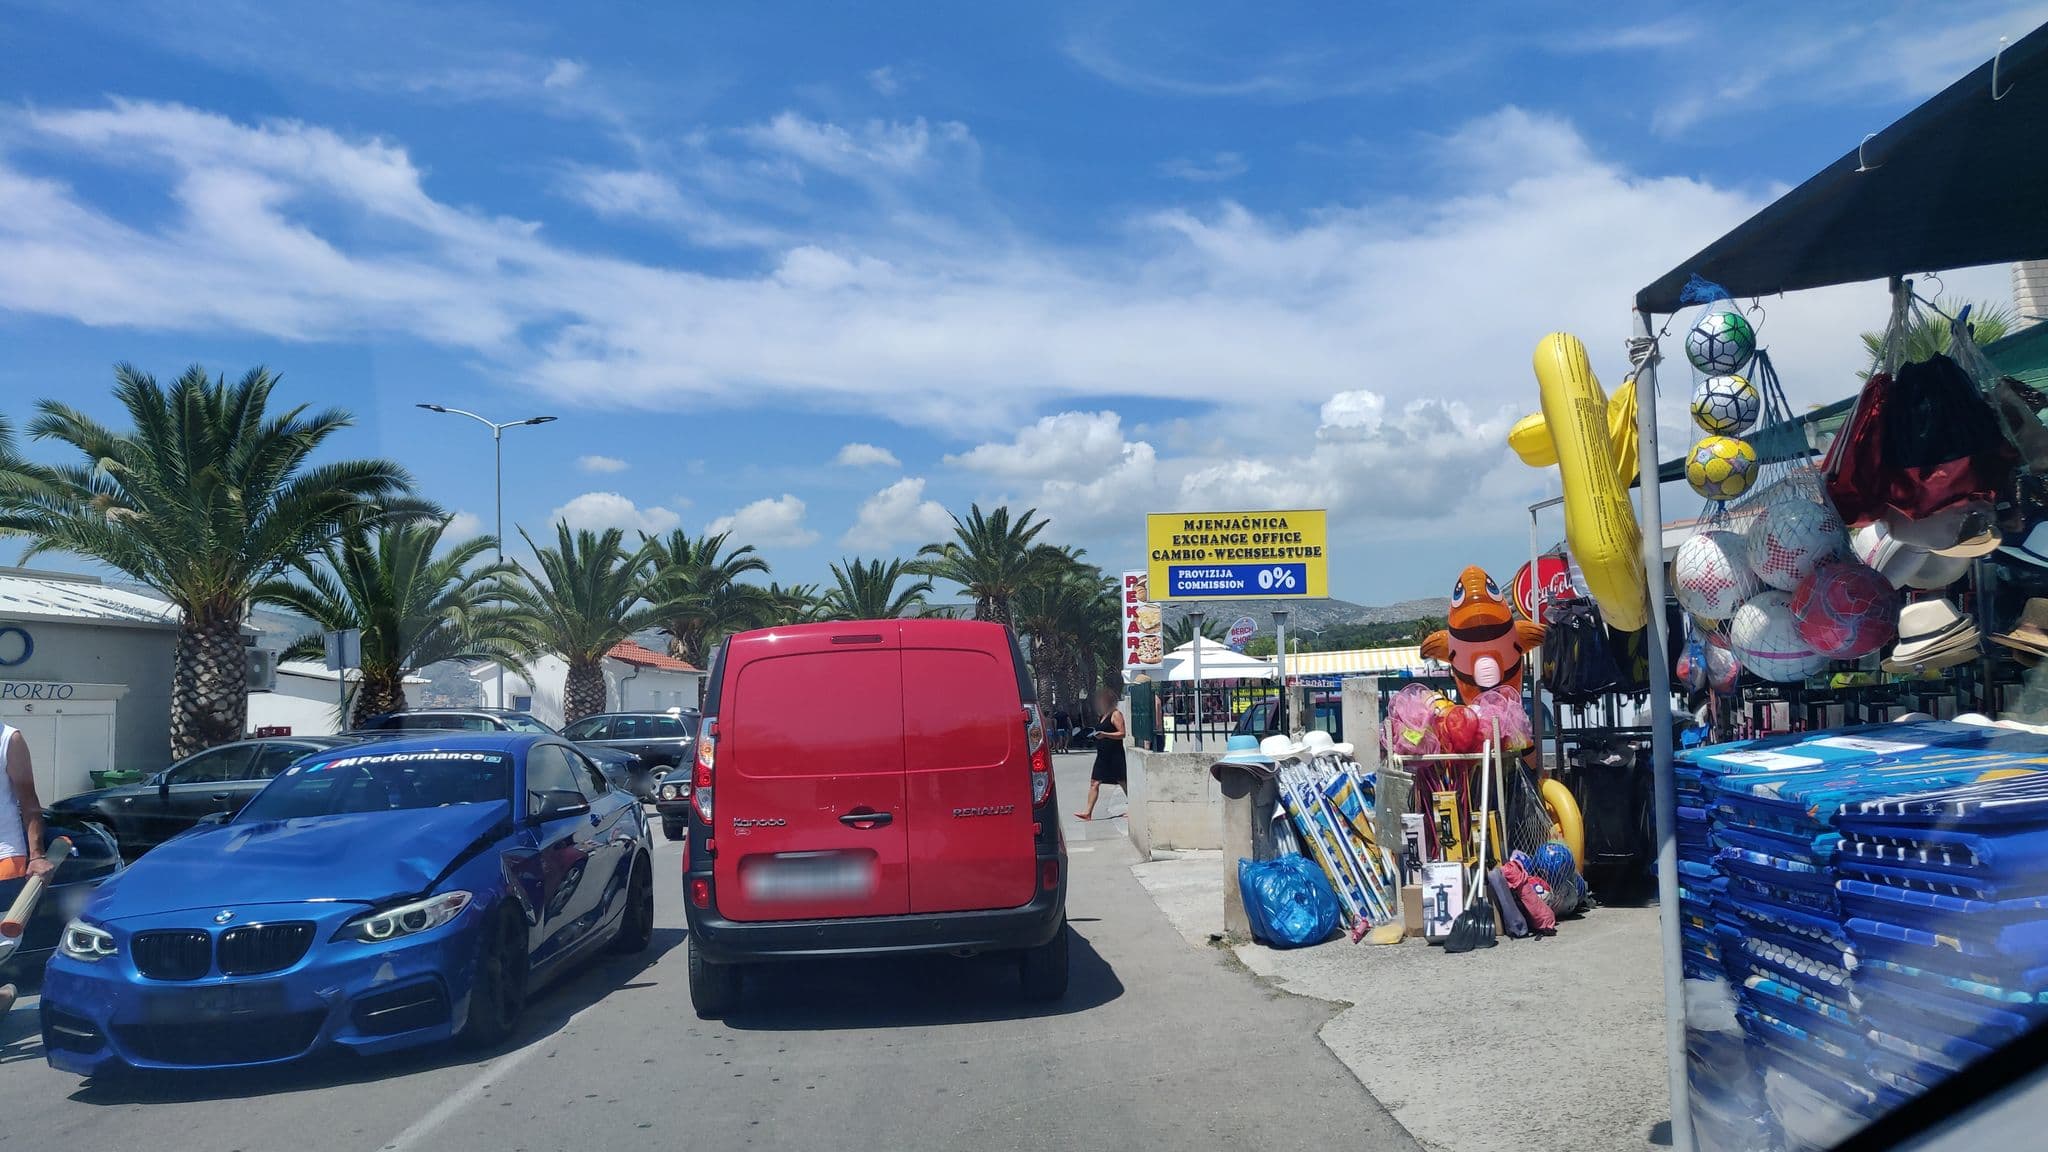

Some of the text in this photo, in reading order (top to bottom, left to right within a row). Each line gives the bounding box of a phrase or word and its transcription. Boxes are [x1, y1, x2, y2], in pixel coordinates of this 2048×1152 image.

[1184, 516, 1288, 531] MJENJAČNICA
[1172, 532, 1302, 545] EXCHANGE OFFICE
[1152, 549, 1206, 561] CAMBIO
[1214, 546, 1322, 560] WECHSELSTUBE
[1178, 569, 1233, 579] PROVIZIJA
[1258, 566, 1296, 590] 0%
[1178, 580, 1244, 590] COMMISSION
[1125, 575, 1141, 665] PEKARA
[1, 683, 74, 699] PORTO
[356, 752, 485, 765] Performance
[952, 804, 1015, 817] RENAULT
